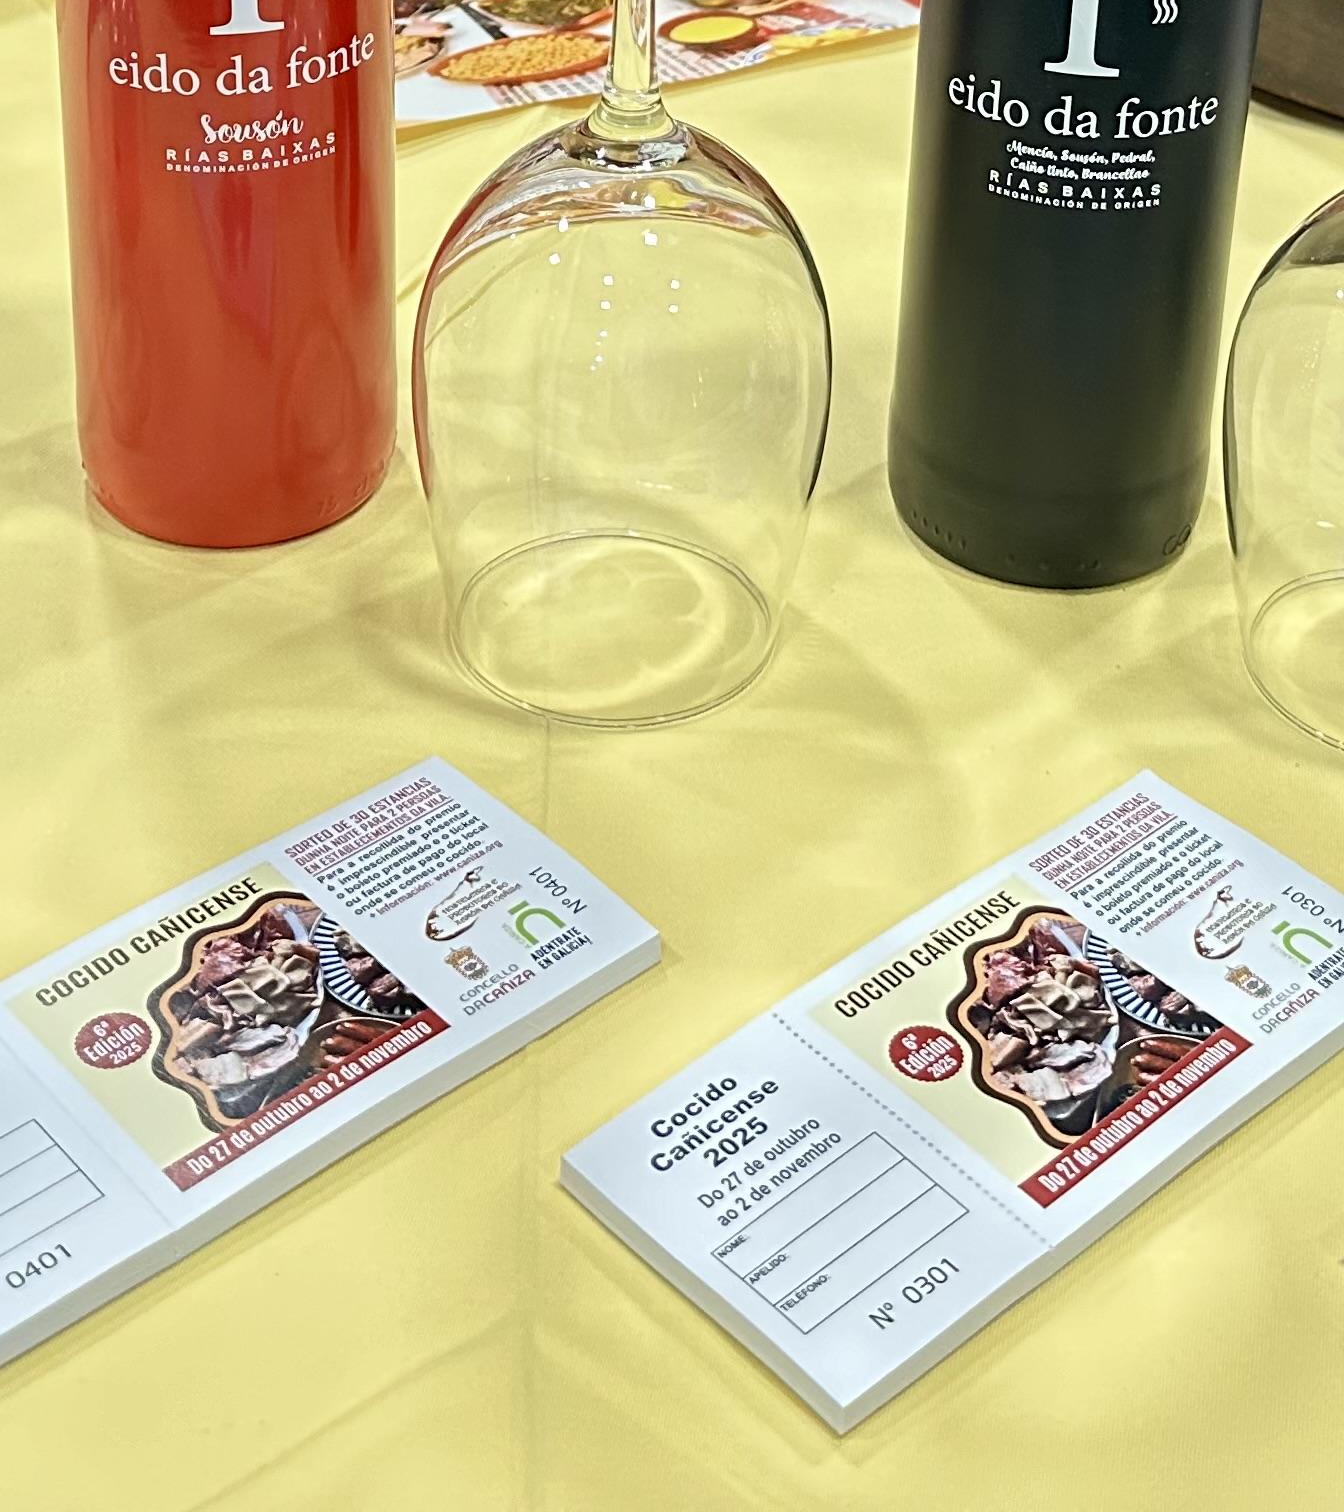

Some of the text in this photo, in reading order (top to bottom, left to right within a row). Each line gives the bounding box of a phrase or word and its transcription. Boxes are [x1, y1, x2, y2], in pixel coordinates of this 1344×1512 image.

[108, 31, 375, 97] eido da fonte
[200, 110, 305, 145] Sousón
[948, 74, 1219, 138] eido da fonte
[166, 132, 336, 163] RÍAS BAIXAS
[166, 145, 336, 173] DENOMINACIÓN DE ORIGEN
[988, 183, 1160, 210] DENOMINACIÓN DE ORIGEN
[990, 169, 1161, 199] RÍAS BAIXAS
[1028, 842, 1067, 873] SORTEO
[1280, 885, 1325, 916] 0301
[35, 876, 263, 1007] COCIDO CAÑICENSE
[834, 890, 1020, 1019] COCIDO CAÑICENSE
[84, 1021, 146, 1062] Edición
[109, 1041, 143, 1065] 2025
[898, 1035, 955, 1074] Edición
[1178, 1039, 1237, 1089] novembro
[649, 1077, 780, 1172] Cañicense
[650, 1076, 738, 1140] Cocido
[697, 1116, 821, 1210] Do 27 de outubro
[704, 1115, 769, 1169] 2025
[717, 1130, 842, 1227] ao 2 de novembro
[4, 1243, 73, 1289] 0401
[869, 1257, 962, 1330] Nº 0301
